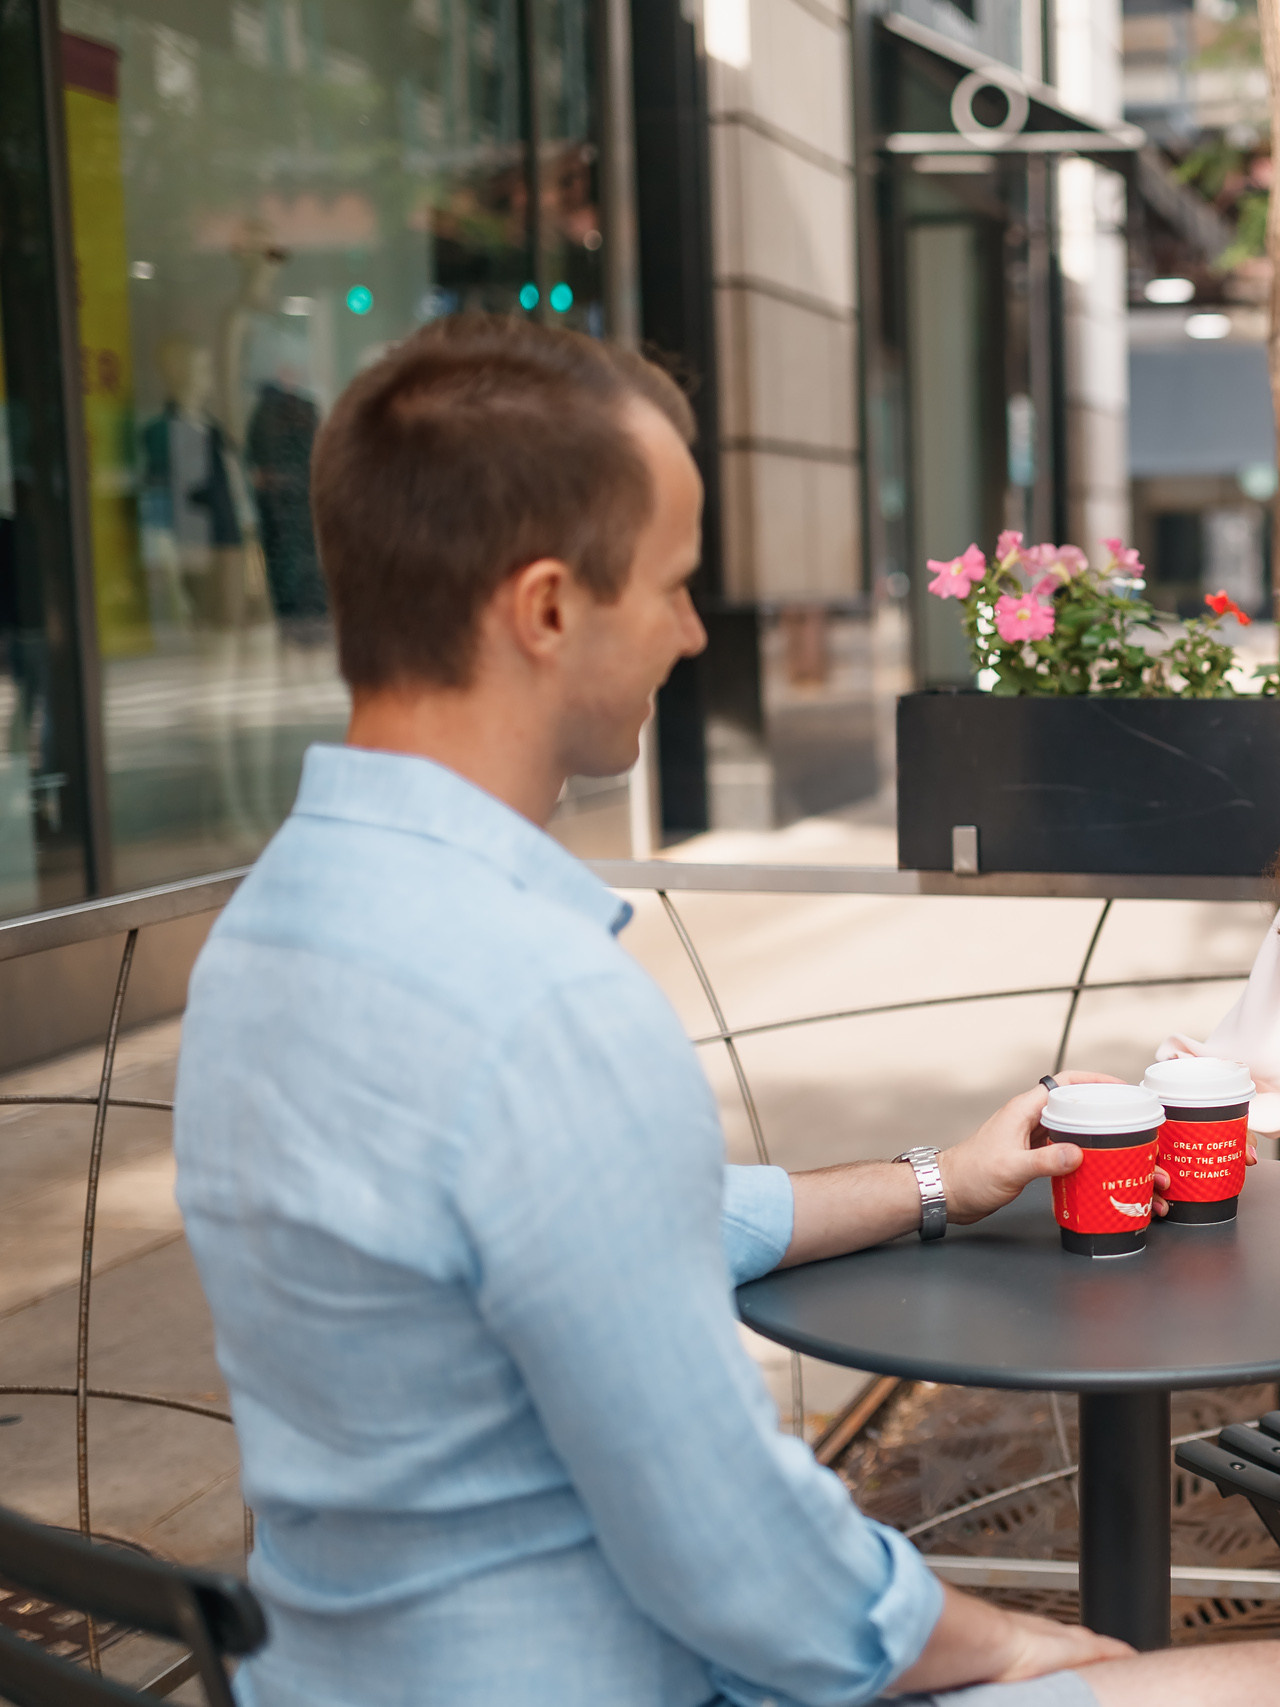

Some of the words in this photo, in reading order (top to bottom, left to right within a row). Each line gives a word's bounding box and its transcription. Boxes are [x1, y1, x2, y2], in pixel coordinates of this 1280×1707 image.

[1173, 1141, 1204, 1150] GREAT
[1206, 1139, 1237, 1150] COFFEE
[1163, 1153, 1172, 1161] IS
[1174, 1155, 1193, 1164] NOT
[1196, 1157, 1214, 1165] THE
[1217, 1150, 1243, 1163] RESULT
[1179, 1169, 1191, 1177] OF
[1194, 1169, 1231, 1179] CHANCE.
